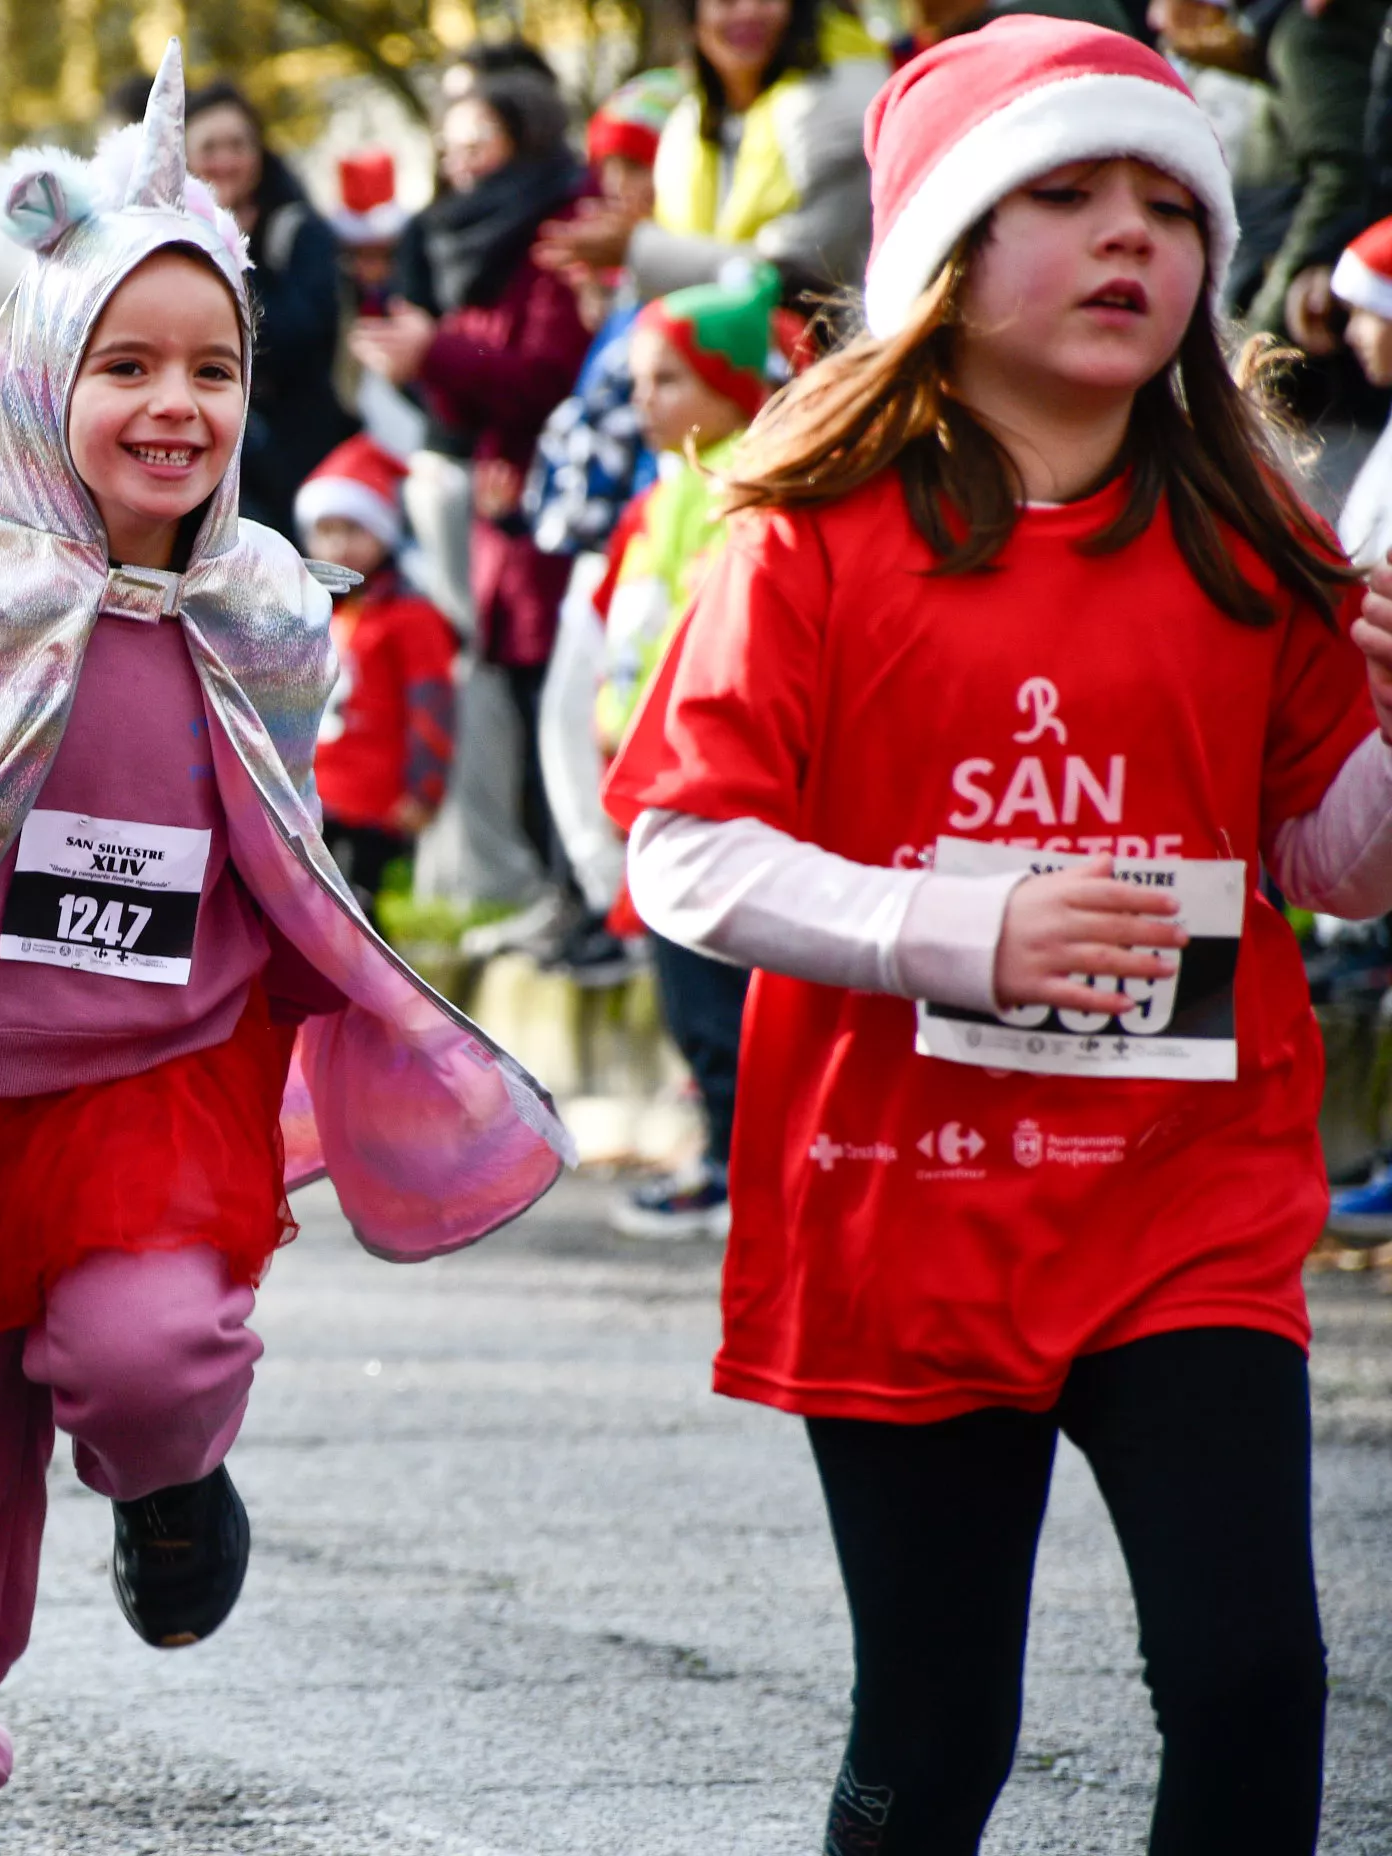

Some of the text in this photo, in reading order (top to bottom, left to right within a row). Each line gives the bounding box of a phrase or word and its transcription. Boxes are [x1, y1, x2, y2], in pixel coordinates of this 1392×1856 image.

[947, 754, 1126, 830] SAN
[66, 836, 165, 860] SAN SILVESTRE
[89, 853, 146, 876] XLIV
[56, 893, 153, 949] 1247
